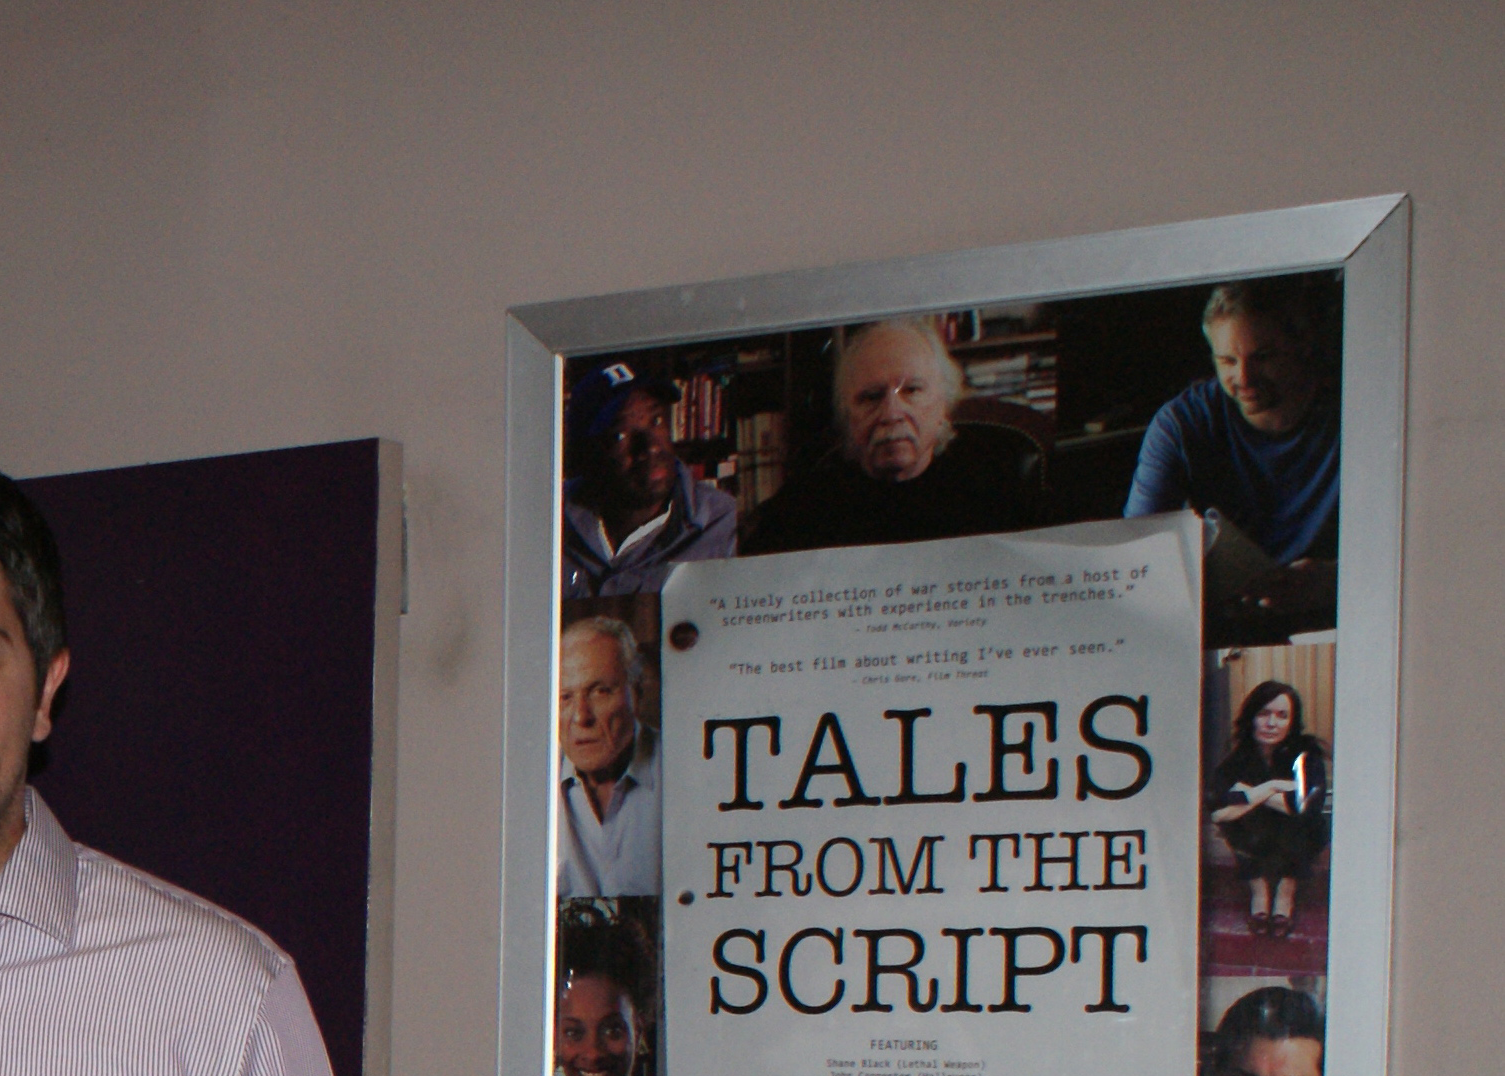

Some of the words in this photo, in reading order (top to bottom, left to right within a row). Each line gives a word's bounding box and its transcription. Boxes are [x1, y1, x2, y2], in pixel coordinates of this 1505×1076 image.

[734, 594, 782, 609] lively
[792, 585, 876, 605] collection
[885, 584, 902, 597] of
[911, 583, 937, 596] war
[947, 577, 1009, 593] stories
[1020, 573, 1055, 589] from
[1064, 573, 1073, 585] a
[1083, 568, 1119, 583] host
[1130, 565, 1148, 579] of
[722, 608, 828, 627] screenwriters
[837, 605, 872, 618] with
[881, 599, 968, 617] experience
[979, 595, 996, 608] in
[1006, 593, 1032, 606] the
[770, 660, 803, 673] best
[813, 656, 846, 671] film
[855, 654, 897, 668] about
[907, 650, 968, 665] writing
[1022, 645, 1059, 658] ever
[703, 694, 1153, 812] TALES
[707, 835, 945, 898] FROM
[969, 829, 1147, 893] THE
[709, 925, 1149, 1014] SCRIPT
[826, 1058, 855, 1068] Shane
[862, 1059, 890, 1068] Black
[897, 1060, 937, 1070] (Lethal
[944, 1060, 985, 1070] Weapon)
[870, 1039, 938, 1051] FEATURING
